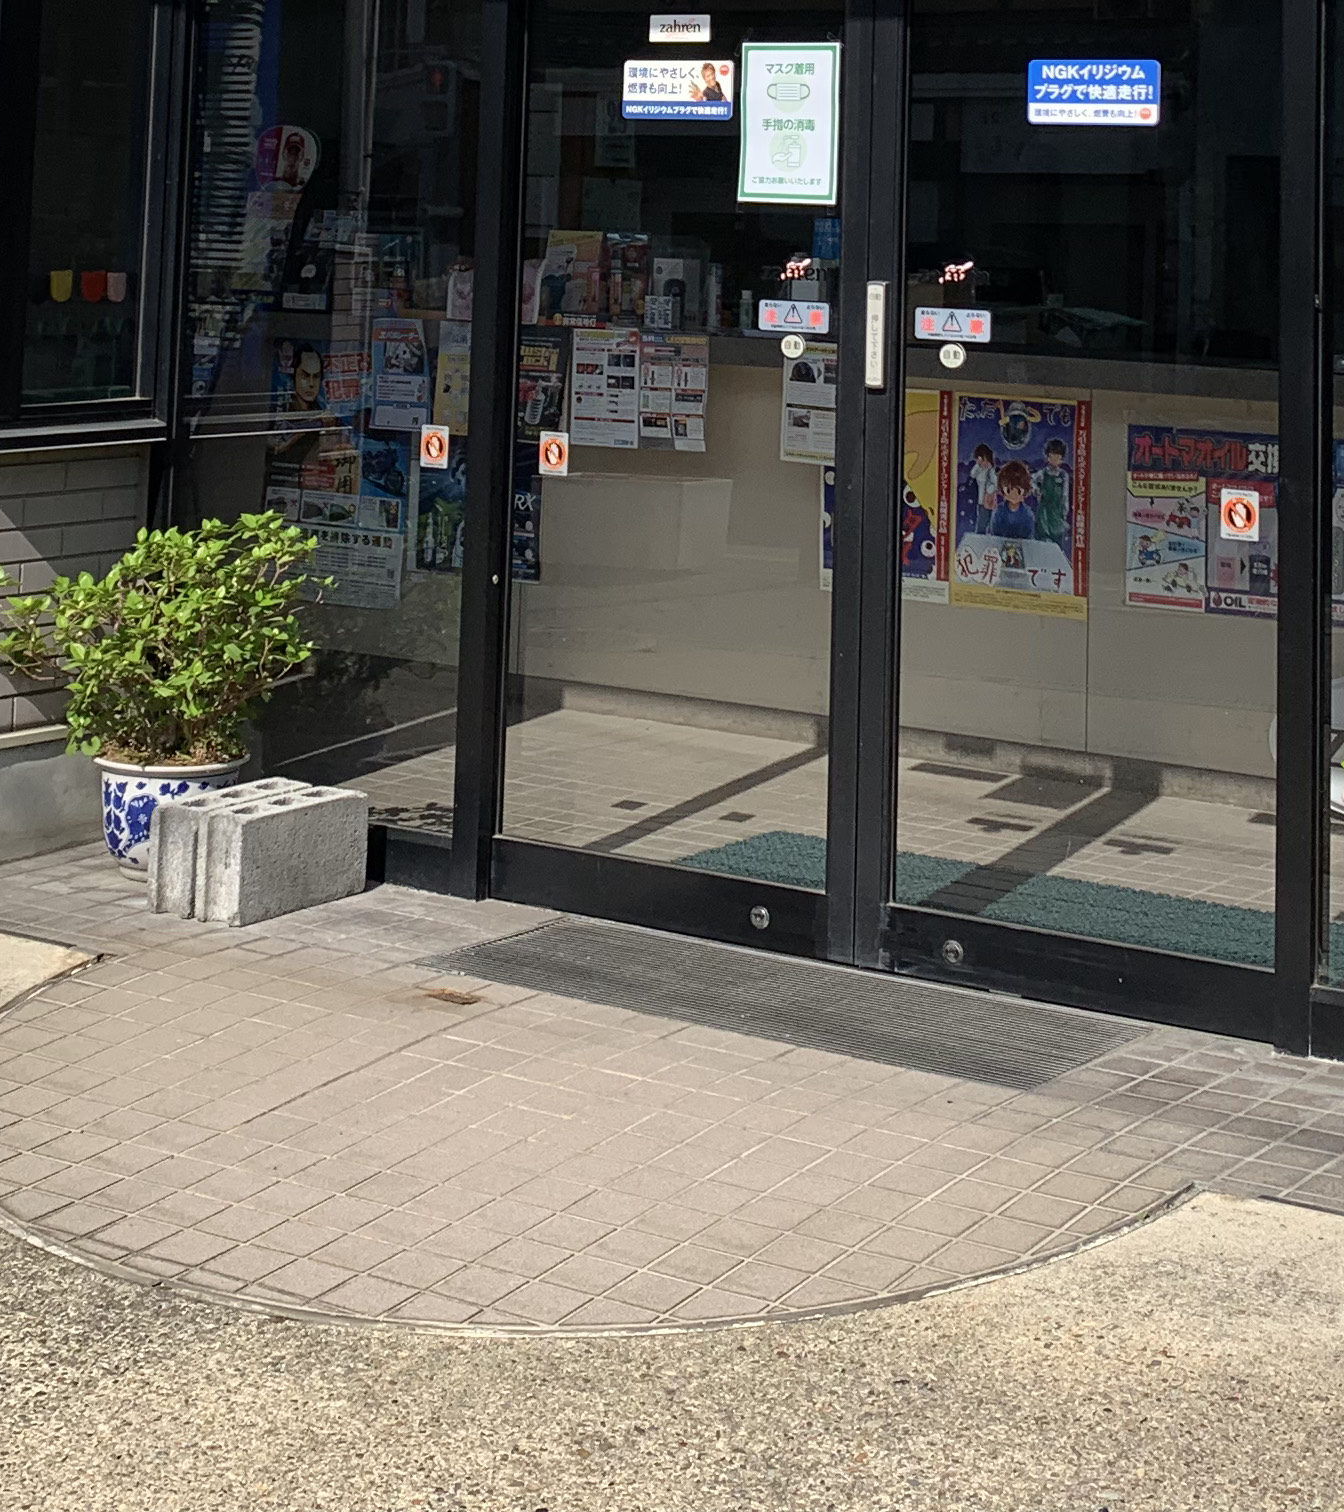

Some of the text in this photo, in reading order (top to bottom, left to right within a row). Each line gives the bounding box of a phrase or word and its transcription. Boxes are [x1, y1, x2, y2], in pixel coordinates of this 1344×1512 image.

[659, 19, 702, 34] zahren
[627, 66, 700, 80] 環境にやさしく、
[764, 62, 816, 76] マスク着用
[1041, 65, 1146, 80] NGKイリジウム
[627, 82, 682, 95] 燃費も向上!
[1033, 84, 1154, 100] プラグで快適走行!
[761, 118, 816, 132] 手指の消毒
[513, 493, 536, 512] RX
[1223, 595, 1246, 609] OIL
